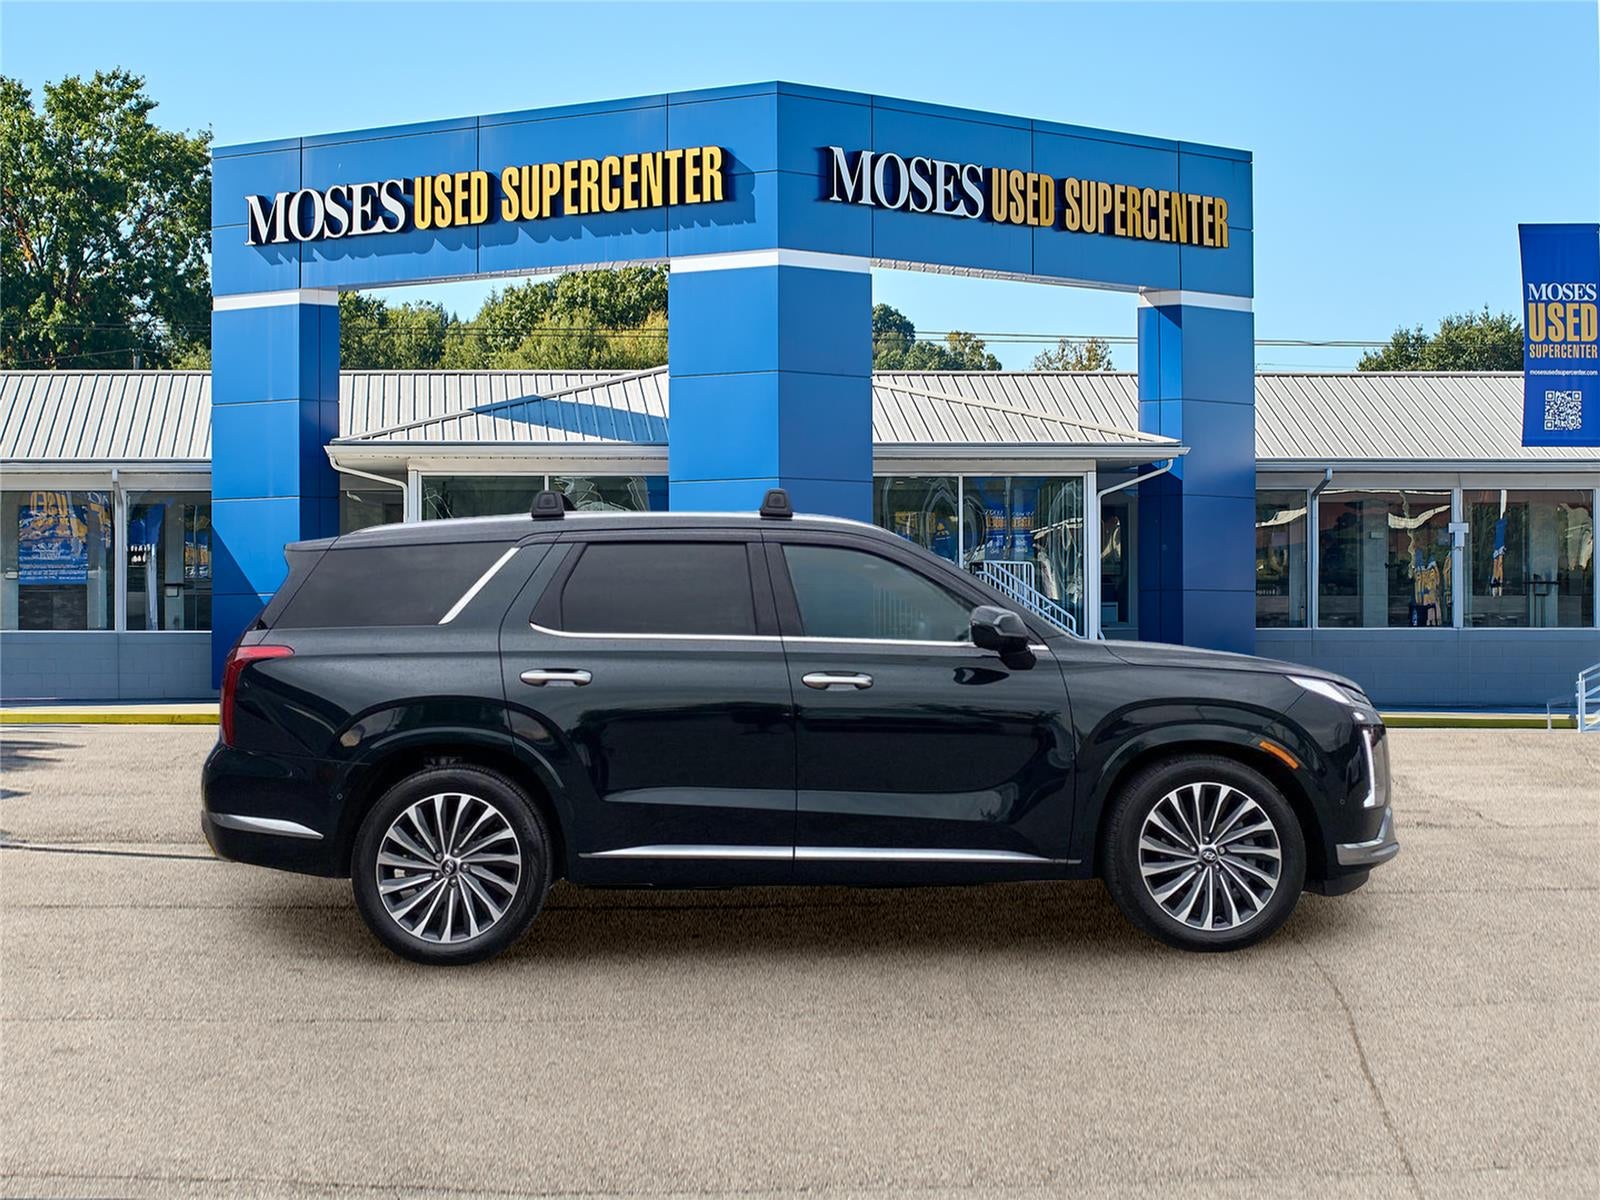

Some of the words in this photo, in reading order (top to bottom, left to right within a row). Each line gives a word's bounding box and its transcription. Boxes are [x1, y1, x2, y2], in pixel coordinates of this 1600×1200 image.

[245, 179, 406, 246] MOSES
[414, 171, 489, 230] USED
[501, 146, 723, 222] SUPERCENTER
[829, 146, 984, 218] MOSES
[991, 168, 1055, 227] USED
[1065, 178, 1230, 248] SUPERCENTER
[1528, 283, 1597, 301] MOSES
[1528, 303, 1598, 342] USED
[1529, 344, 1598, 359] SUPERCENTER
